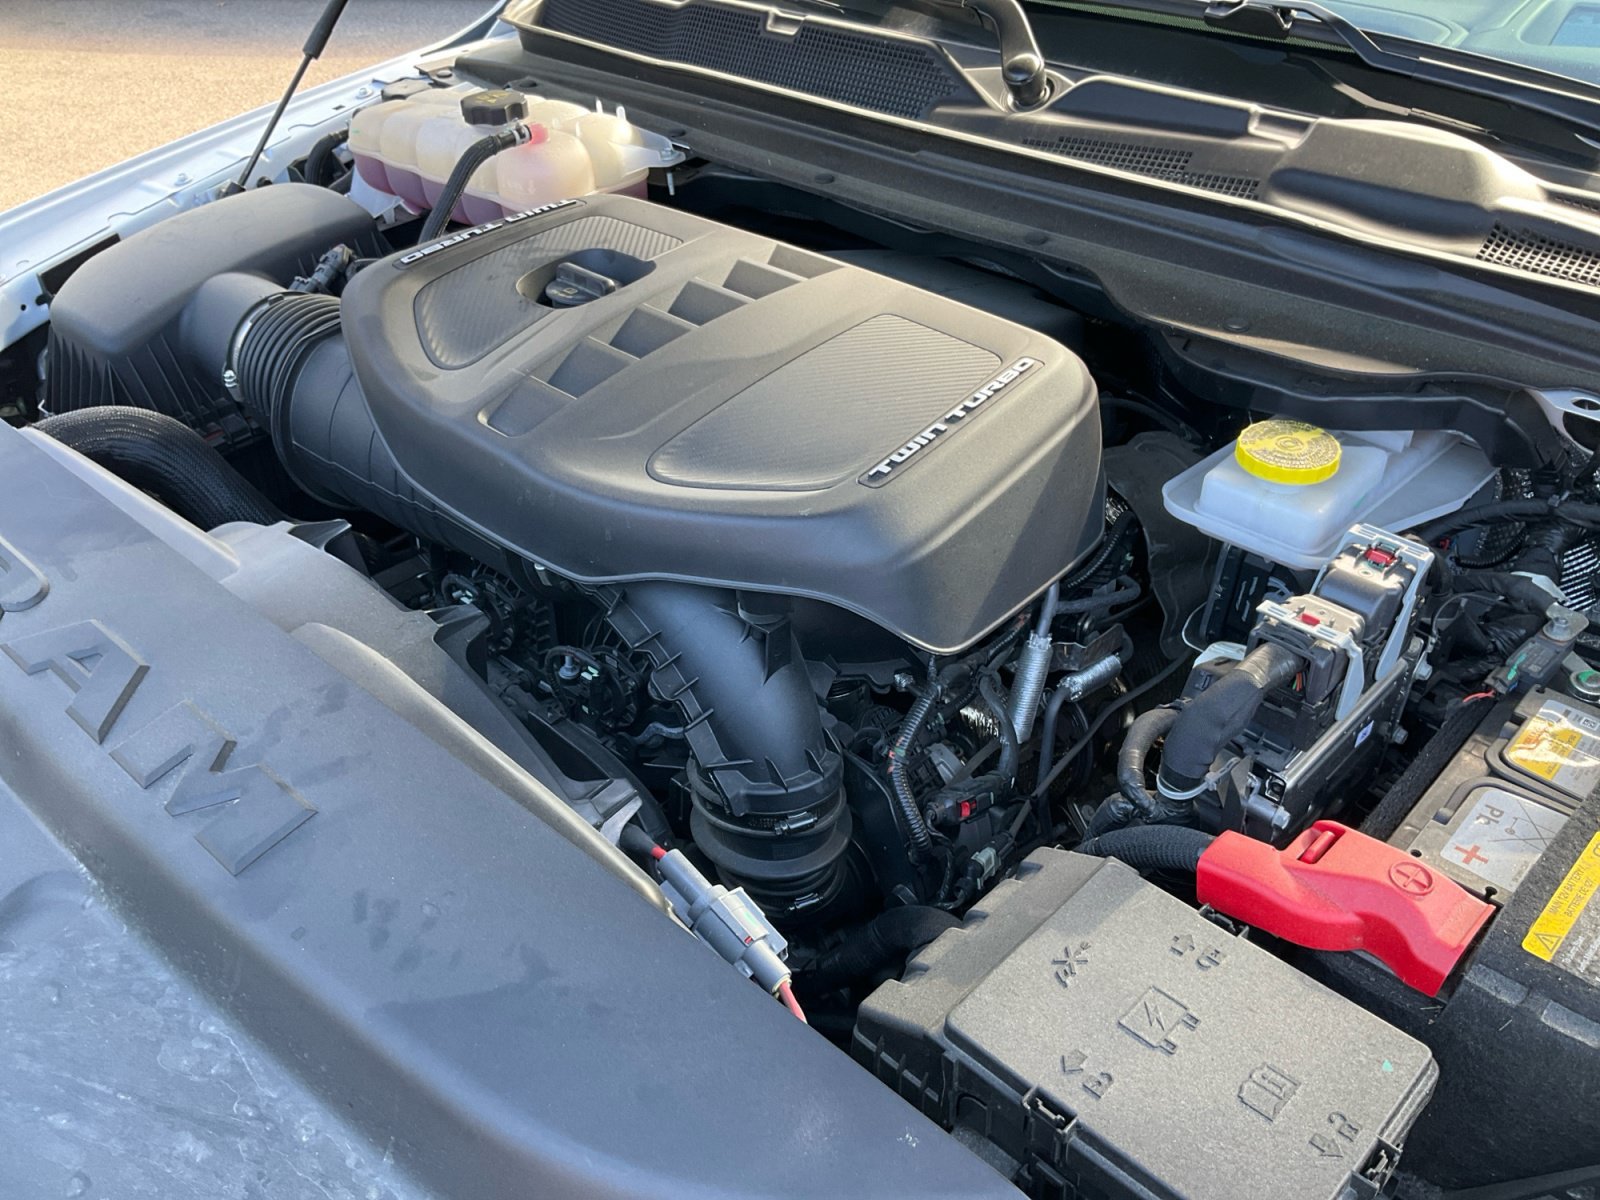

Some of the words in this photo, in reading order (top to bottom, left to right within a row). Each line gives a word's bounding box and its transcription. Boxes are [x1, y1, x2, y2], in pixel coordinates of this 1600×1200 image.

[400, 223, 503, 264] TURBO
[868, 422, 948, 477] TWIN
[945, 357, 1035, 421] TURBO
[1563, 867, 1584, 892] BATTERY
[1563, 892, 1584, 917] BATTERIE
